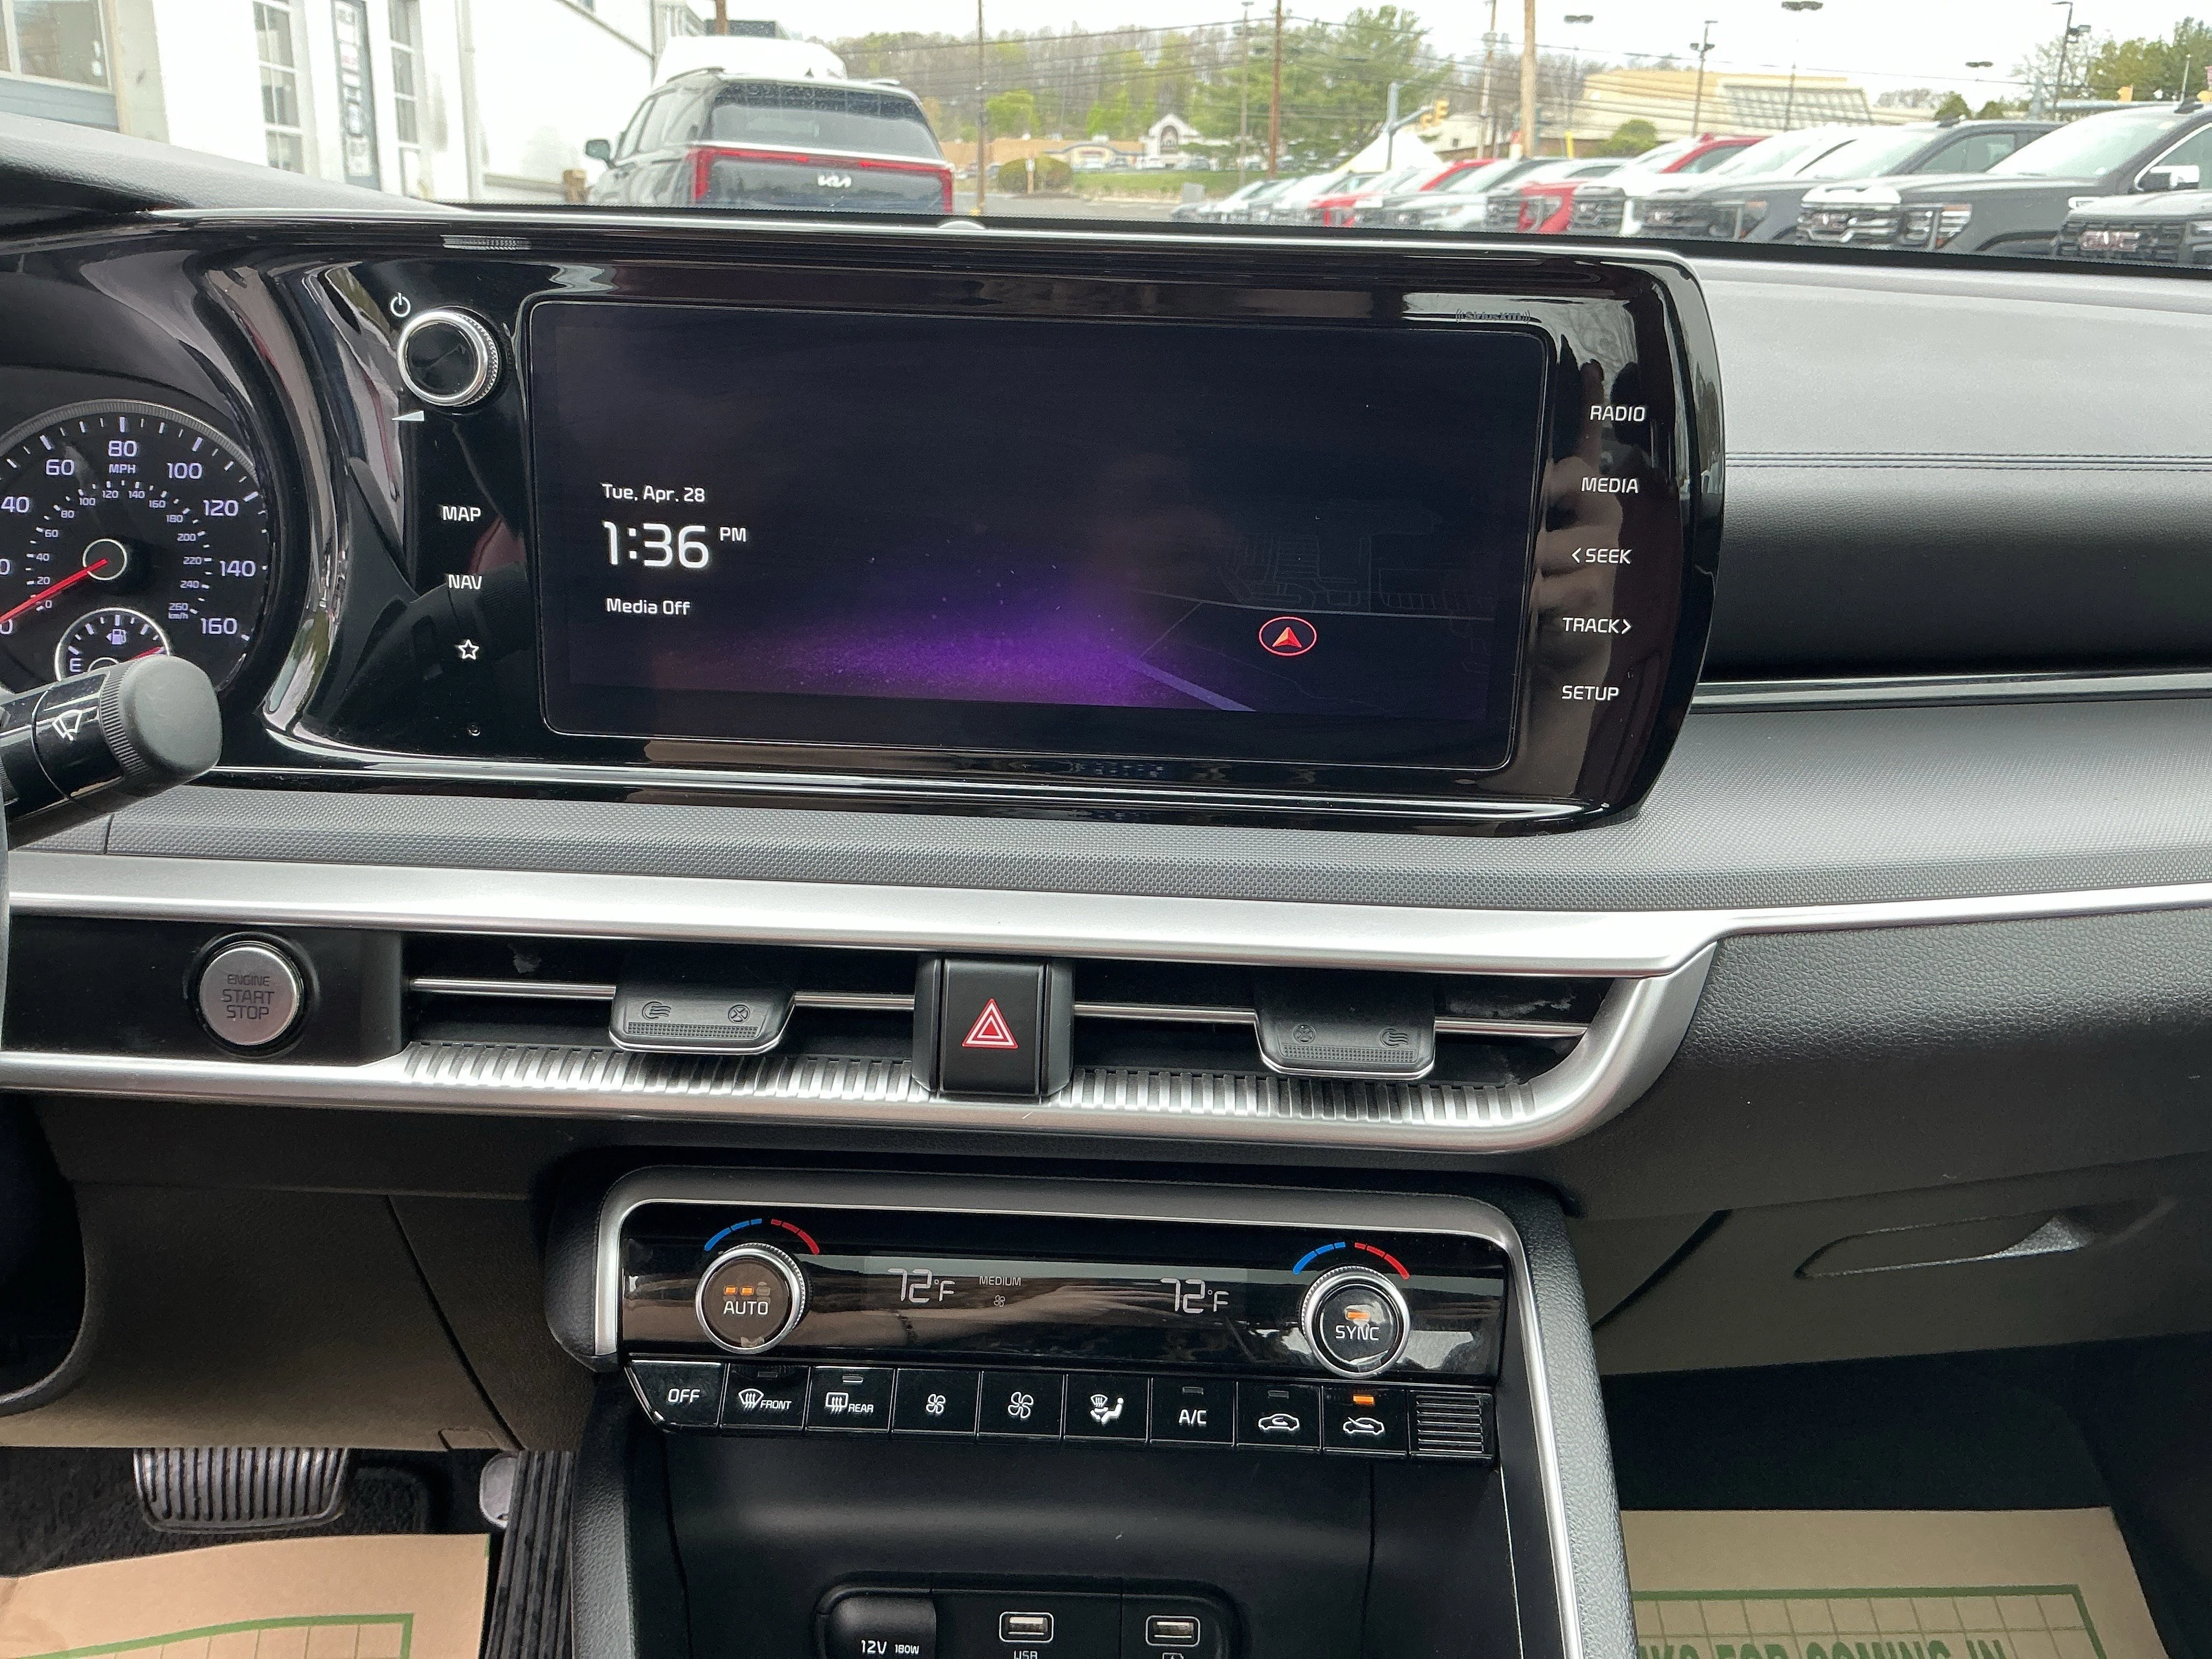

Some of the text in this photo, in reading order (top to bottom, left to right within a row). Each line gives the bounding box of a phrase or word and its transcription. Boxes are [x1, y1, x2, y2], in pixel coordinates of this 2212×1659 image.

[1590, 405, 1645, 421] RADIO
[108, 441, 137, 457] 80
[46, 460, 75, 476] 60
[109, 465, 136, 473] MPH
[167, 463, 202, 479] 100
[1581, 477, 1639, 493] MEDIA
[103, 490, 119, 499] 120
[129, 490, 145, 499] 140
[602, 484, 706, 503] Tue, Apr. 28
[1, 496, 30, 512] 40
[79, 497, 96, 506] 100
[204, 500, 238, 516] 120
[61, 510, 75, 518] 80
[443, 506, 481, 521] MAP
[44, 529, 59, 538] 60
[177, 534, 196, 542] 200
[603, 521, 746, 568] 1:36 PM
[36, 553, 50, 561] 40
[183, 557, 202, 565] 220
[1585, 549, 1632, 564] SEEK
[220, 561, 256, 577] 140
[37, 577, 50, 585] 20
[180, 580, 200, 589] 240
[448, 574, 482, 589] NAV
[45, 600, 52, 608] 0
[606, 598, 691, 615] Media Off
[202, 618, 237, 634] 160
[1562, 617, 1620, 634] TRACK
[70, 657, 82, 672] E
[1562, 685, 1620, 701] SETUP
[227, 974, 270, 986] ENGINE
[223, 989, 274, 1004] START
[227, 1005, 269, 1020] STOP
[979, 1276, 1022, 1286] MEDIUM
[723, 1300, 769, 1315] AUTO
[1335, 1325, 1380, 1341] SYNC
[668, 1389, 701, 1403] OFF
[760, 1400, 792, 1410] FRONT
[848, 1403, 874, 1413] REAR
[1179, 1409, 1207, 1424] A/C
[861, 1639, 920, 1655] 12V 180W
